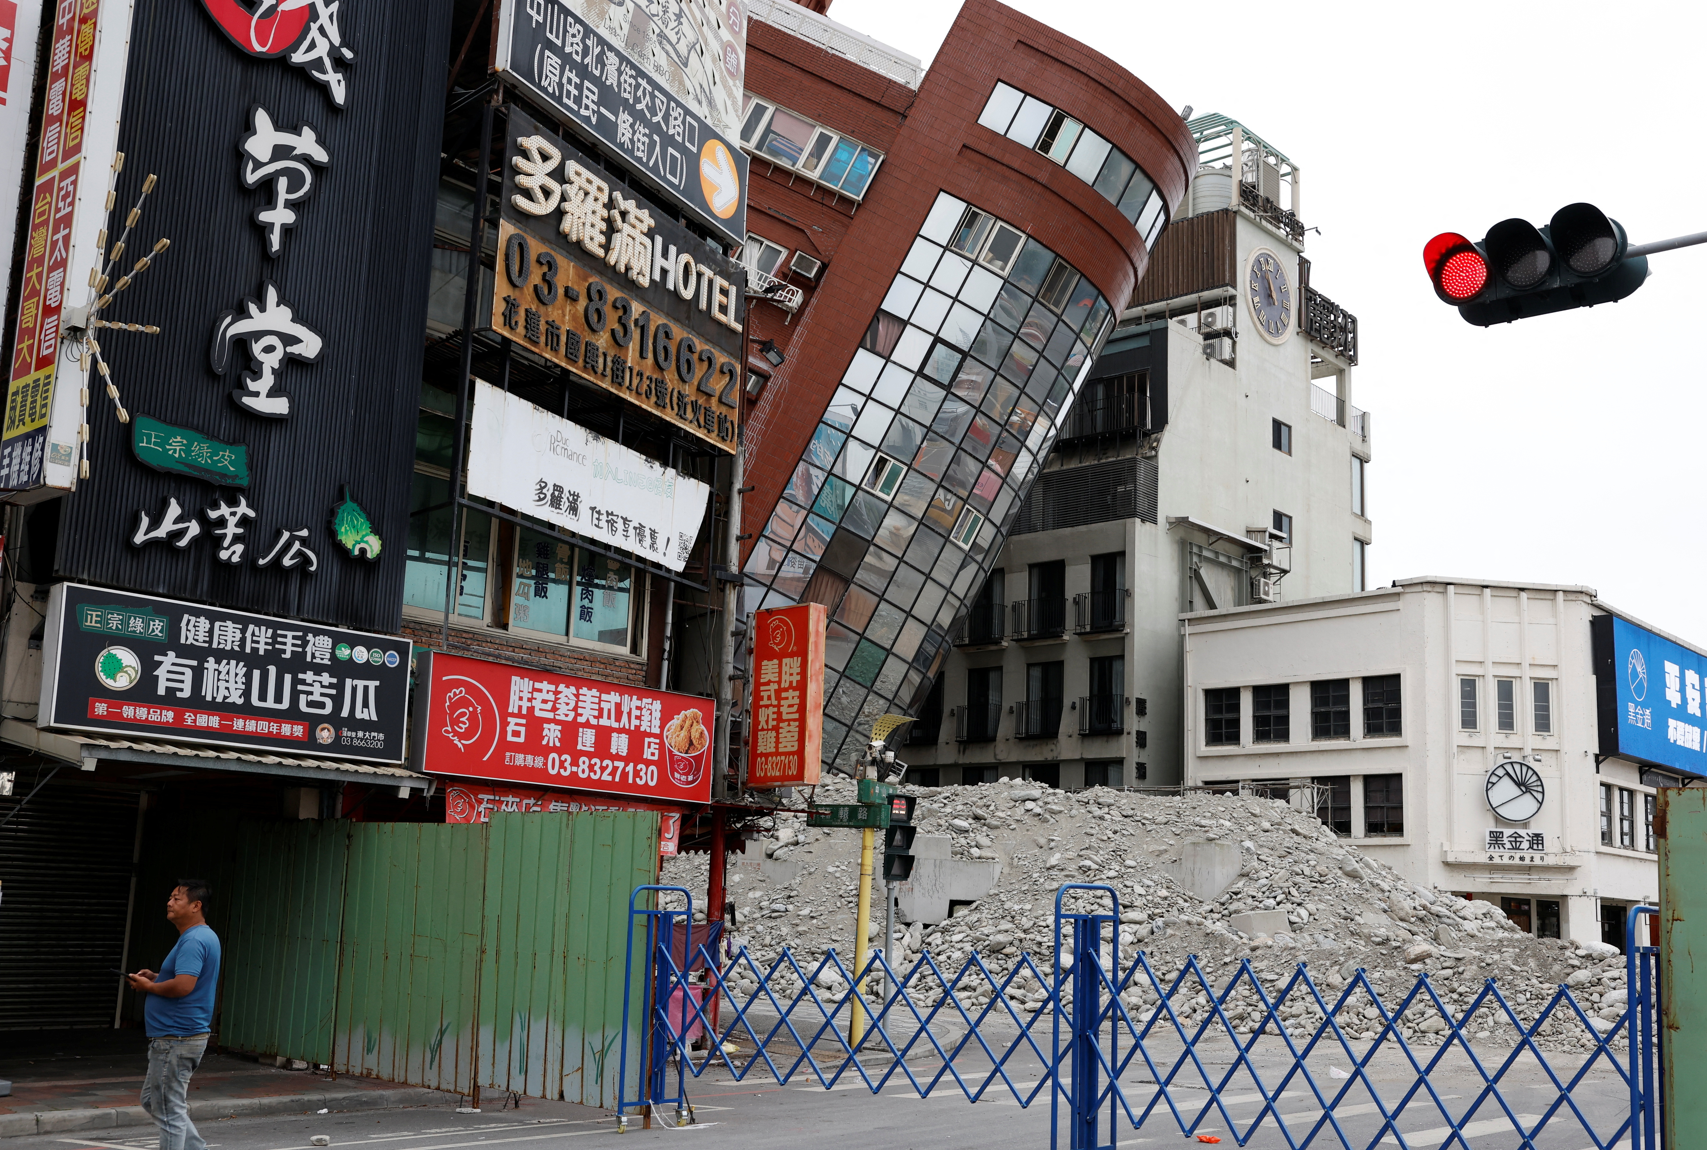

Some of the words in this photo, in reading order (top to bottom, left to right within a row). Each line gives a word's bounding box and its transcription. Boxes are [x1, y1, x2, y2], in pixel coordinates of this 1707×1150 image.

[42, 0, 75, 164] 中華電信
[652, 58, 671, 83] BBQ
[511, 135, 656, 289] 多羅滿
[652, 234, 743, 334] HOTEL
[15, 193, 51, 369] 台灣大哥大
[40, 174, 76, 359] 亞太電信
[505, 232, 738, 409] 03-8316622
[0, 433, 43, 489] 手機維修
[139, 429, 236, 471] 正宗綠皮
[533, 477, 582, 521] 多羅滿
[133, 495, 318, 572] 山苦瓜
[514, 558, 533, 623] 地瓜粥
[534, 541, 551, 600] 雞腿飯
[85, 610, 164, 637] 正宗綠皮
[180, 613, 333, 666] 健康伴手禮
[153, 650, 379, 721] 有機山苦瓜
[507, 675, 662, 734] 胖老爹美式炸雞
[756, 658, 780, 754] 美式炸雞
[778, 656, 802, 752] 胖老爹
[1664, 659, 1707, 719] 平安
[94, 702, 175, 723] 第一領導品牌
[183, 712, 304, 738] 全國唯一連續四年獲獎
[341, 736, 351, 745] 03
[352, 738, 384, 749] 8663200
[506, 716, 660, 761] 石來運轉店
[1627, 702, 1652, 730] 黑金通
[547, 752, 658, 787] 03-8327130
[755, 755, 798, 777] 03-8327130
[1487, 830, 1545, 851] 黑金通
